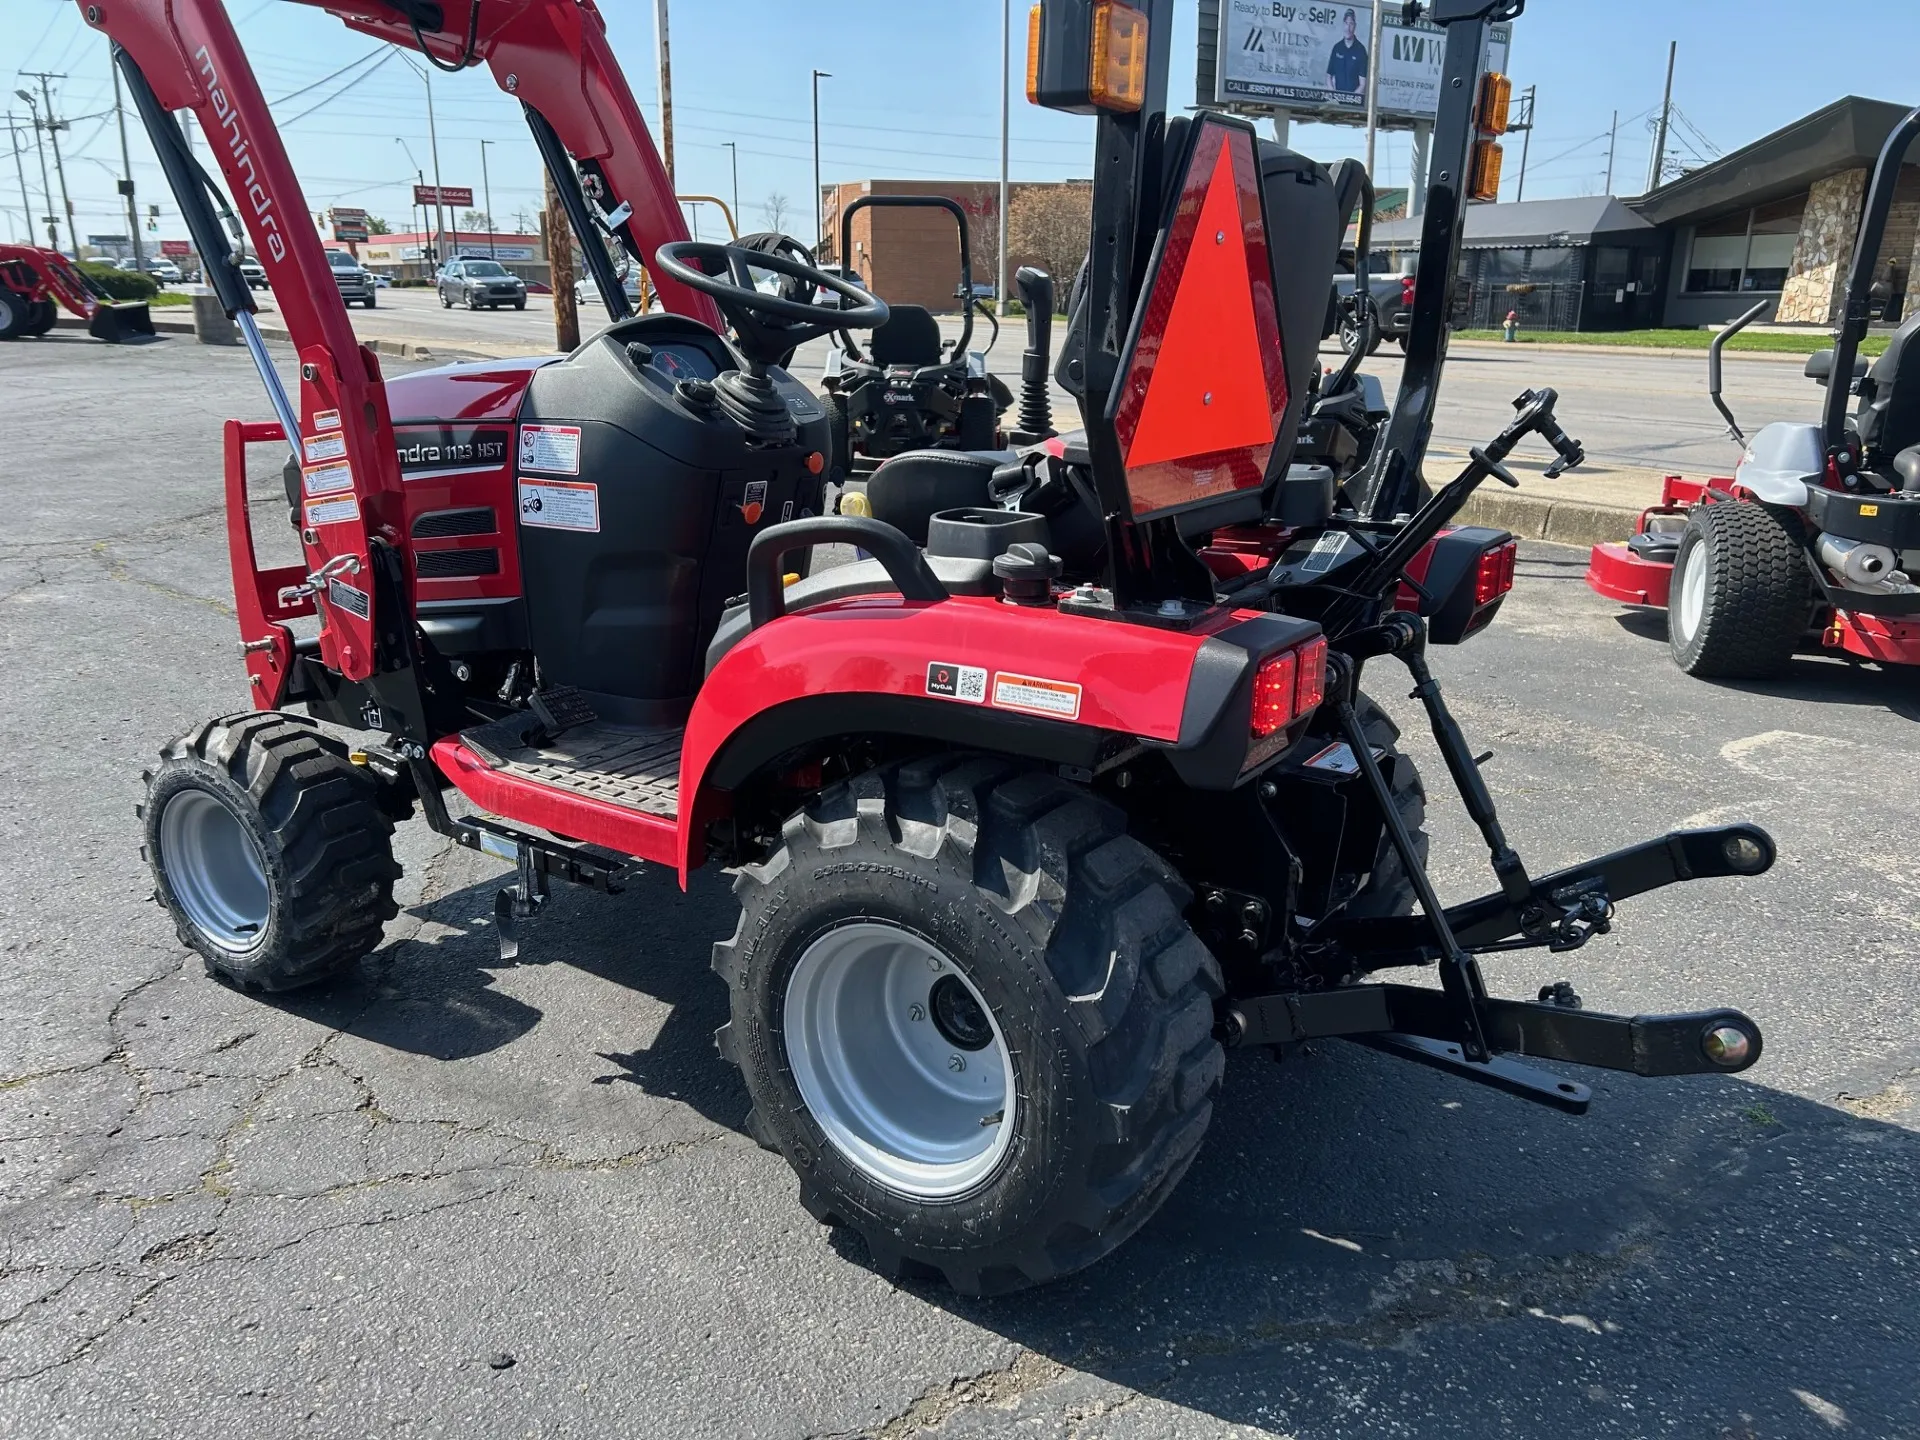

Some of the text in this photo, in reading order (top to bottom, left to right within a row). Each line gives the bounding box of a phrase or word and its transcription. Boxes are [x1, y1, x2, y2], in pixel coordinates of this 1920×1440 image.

[1234, 1, 1337, 24] Ready to Buy or Sell?
[1271, 31, 1310, 47] MILLS
[1274, 64, 1297, 77] Realty
[1227, 81, 1247, 92] CALL
[1247, 84, 1275, 95] JEREMY
[1275, 87, 1295, 98] MILLS
[1378, 77, 1435, 91] SOLUTIONS FROM
[195, 46, 287, 264] mahindra
[416, 188, 471, 198] Walreens
[1296, 434, 1316, 444] ark
[397, 443, 440, 463] ndra
[477, 442, 503, 458] HST
